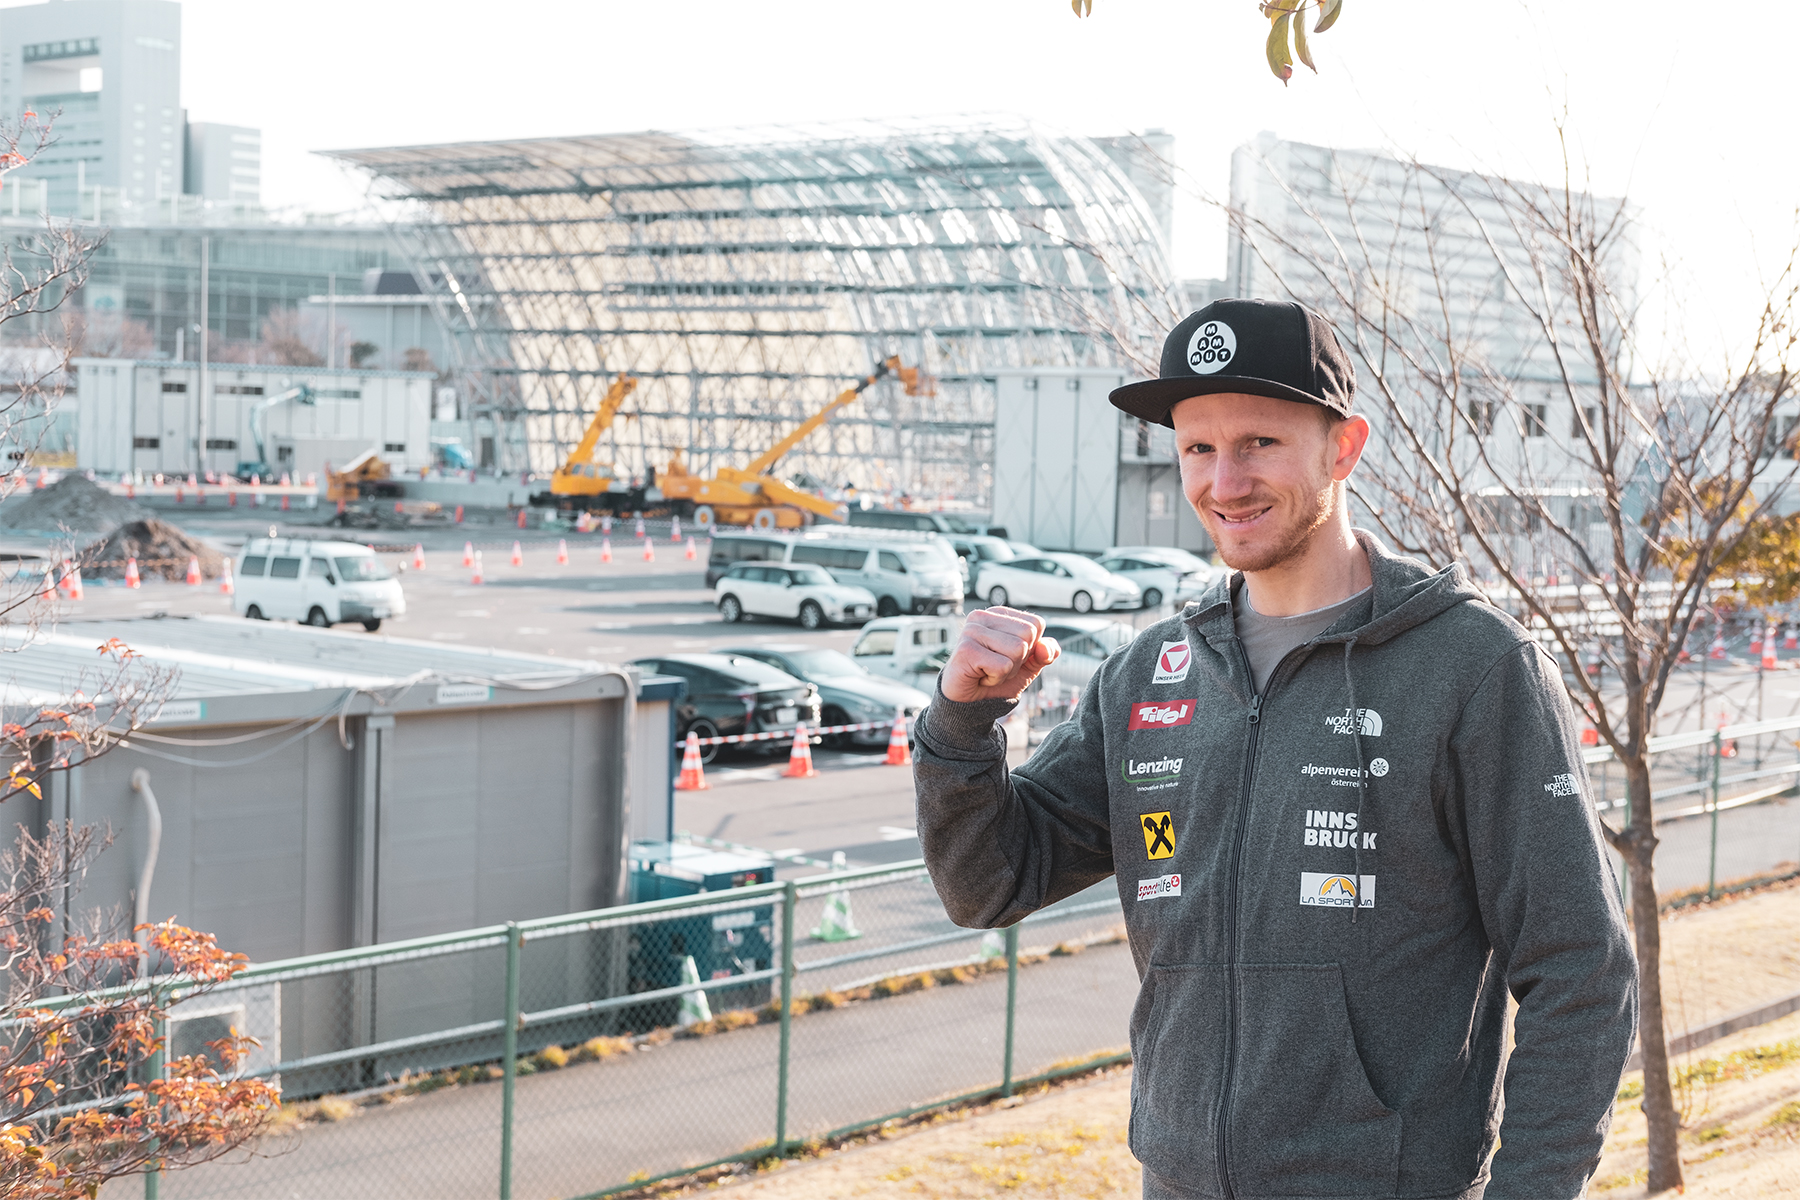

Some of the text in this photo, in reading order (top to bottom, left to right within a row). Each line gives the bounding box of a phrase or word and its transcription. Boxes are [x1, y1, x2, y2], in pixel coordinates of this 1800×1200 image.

[1138, 703, 1189, 725] Tirol
[1128, 755, 1184, 776] Lenzing
[1330, 778, 1368, 789] österrei
[1553, 774, 1568, 782] THE
[1544, 781, 1570, 791] NORTH
[1552, 788, 1572, 797] FACE
[1305, 809, 1358, 830] INNS
[1304, 828, 1378, 850] BRUCK
[1301, 896, 1373, 907] LA SPORTVA
